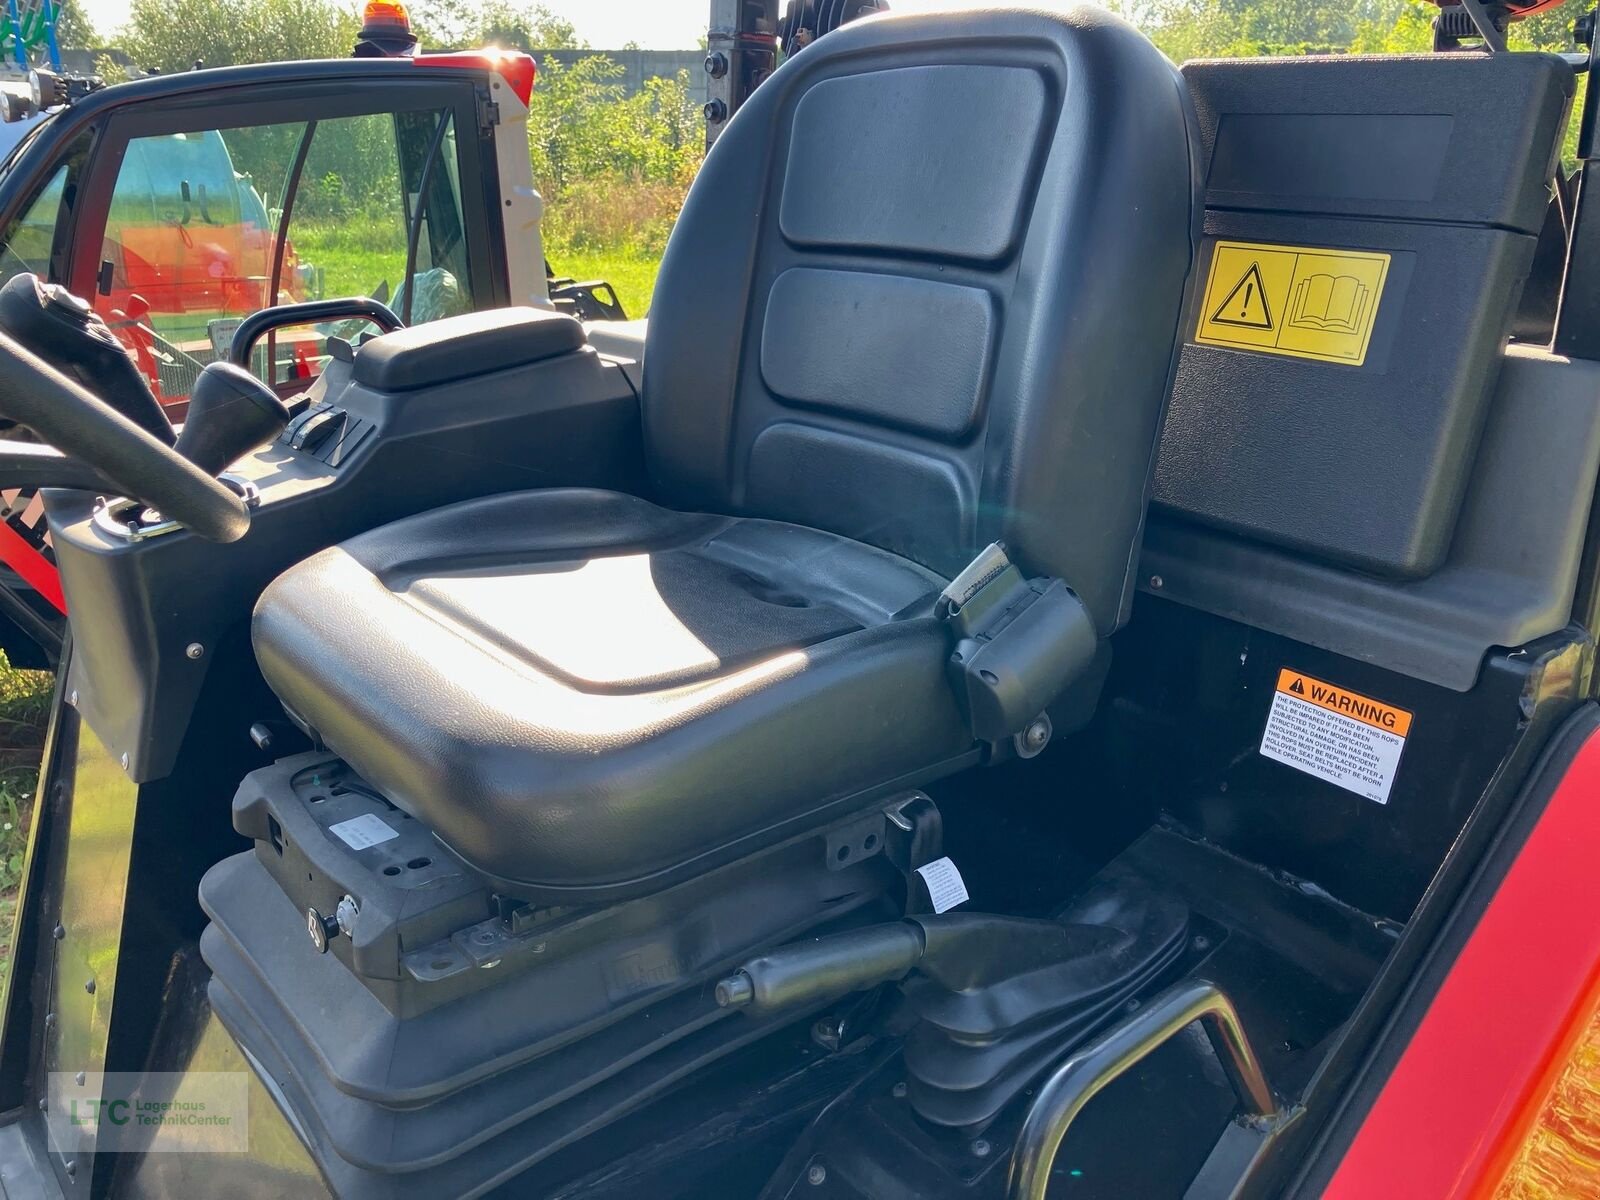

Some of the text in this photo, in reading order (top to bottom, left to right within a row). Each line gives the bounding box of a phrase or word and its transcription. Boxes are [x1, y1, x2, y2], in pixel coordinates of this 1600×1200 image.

[1275, 703, 1289, 712] WILL
[1299, 711, 1325, 725] IMPARED
[1339, 727, 1352, 736] HAS
[1353, 732, 1370, 743] BEEN
[1277, 695, 1399, 745] THE PROTECTION OFFERED BY THIS ROPS
[1311, 685, 1397, 728] WARNING
[1270, 723, 1297, 738] INVOLVED
[1314, 740, 1347, 757] OVERTURN
[1271, 716, 1380, 762] STRUCTURAL DAMAGE, OR HAS BEEN
[1273, 709, 1307, 726] SUBJECTED
[1317, 726, 1329, 735] ANY
[1330, 731, 1375, 752] MODIFICATION,
[1264, 743, 1282, 754] WHILE
[1283, 751, 1316, 768] OPERATING
[1268, 730, 1280, 739] THIS
[1281, 735, 1297, 745] ROPS
[1298, 742, 1315, 752] MUST
[1315, 748, 1324, 756] BE
[1324, 752, 1357, 769] REPLACED
[1358, 765, 1378, 778] AFTER
[1299, 750, 1313, 759] SEAT
[1314, 756, 1333, 767] BELTS
[1334, 764, 1351, 774] MUST
[1352, 771, 1361, 779] BE
[1362, 775, 1382, 787] WORN
